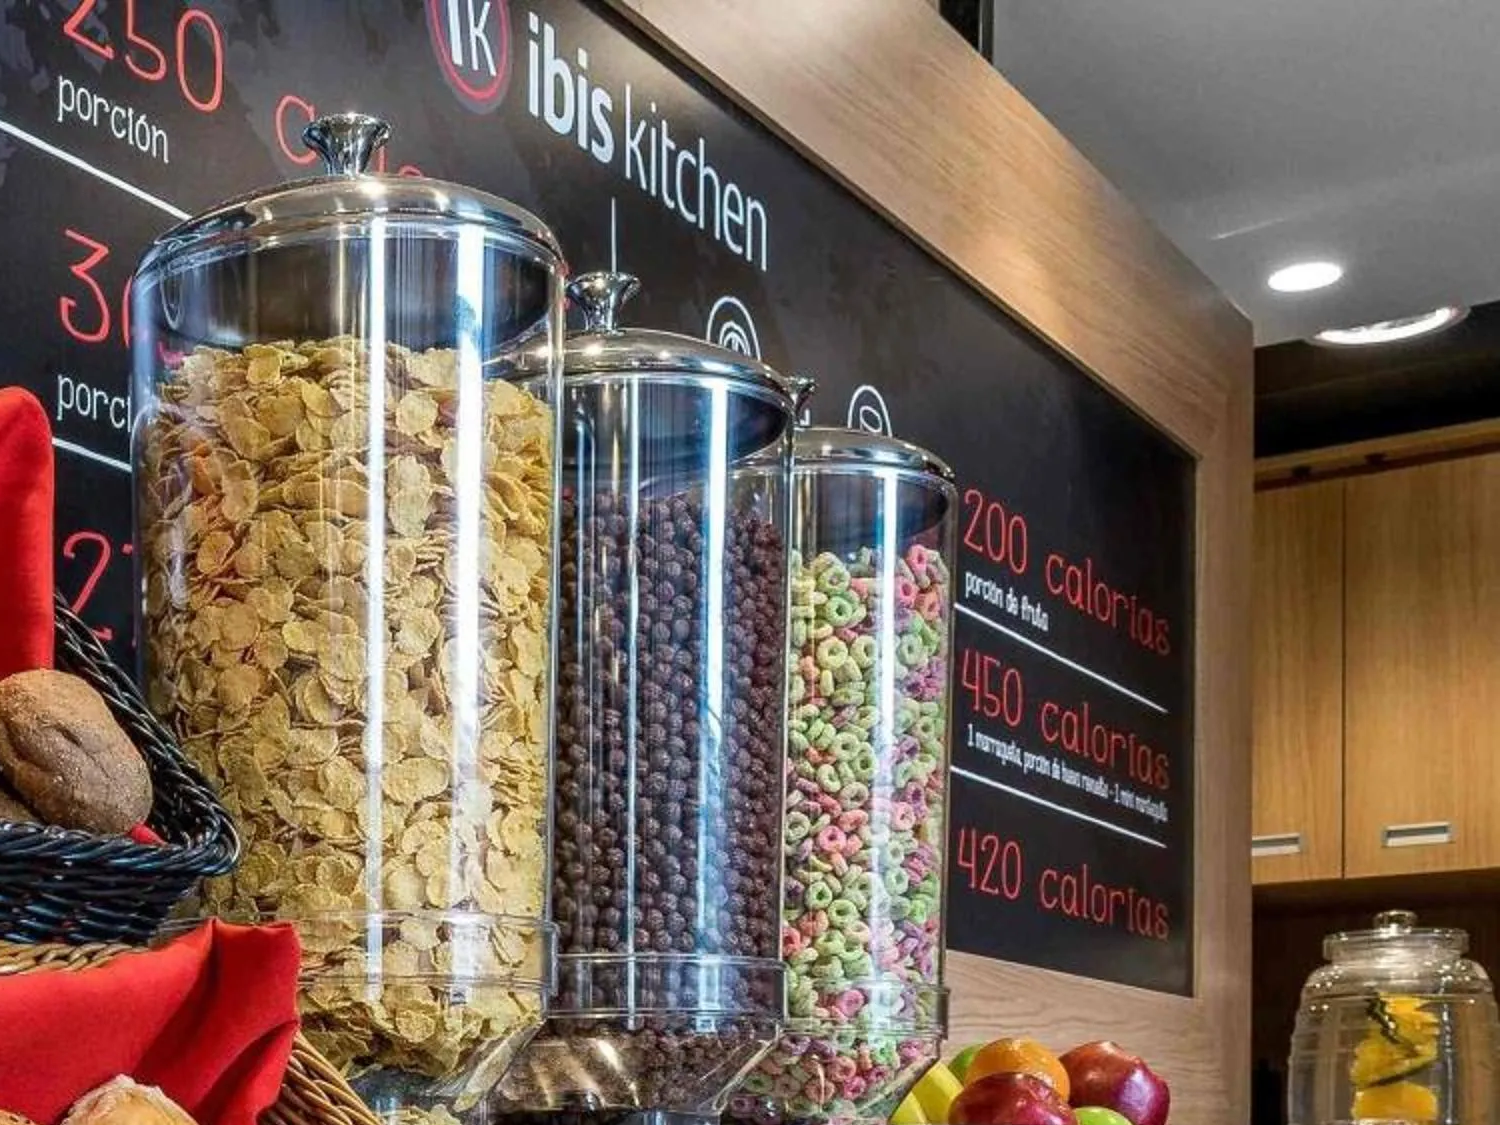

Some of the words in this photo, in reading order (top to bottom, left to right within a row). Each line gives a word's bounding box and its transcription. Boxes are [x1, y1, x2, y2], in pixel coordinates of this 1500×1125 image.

[63, 0, 224, 112] 250
[57, 75, 169, 164] porción
[528, 11, 615, 164] ibis
[625, 83, 768, 272] kitchen
[964, 489, 1028, 574] 200
[1045, 553, 1171, 656] calorias
[962, 649, 1024, 728] 450
[1040, 702, 1170, 790] calorias
[958, 828, 1023, 900] 420
[1040, 863, 1170, 939] calorias
